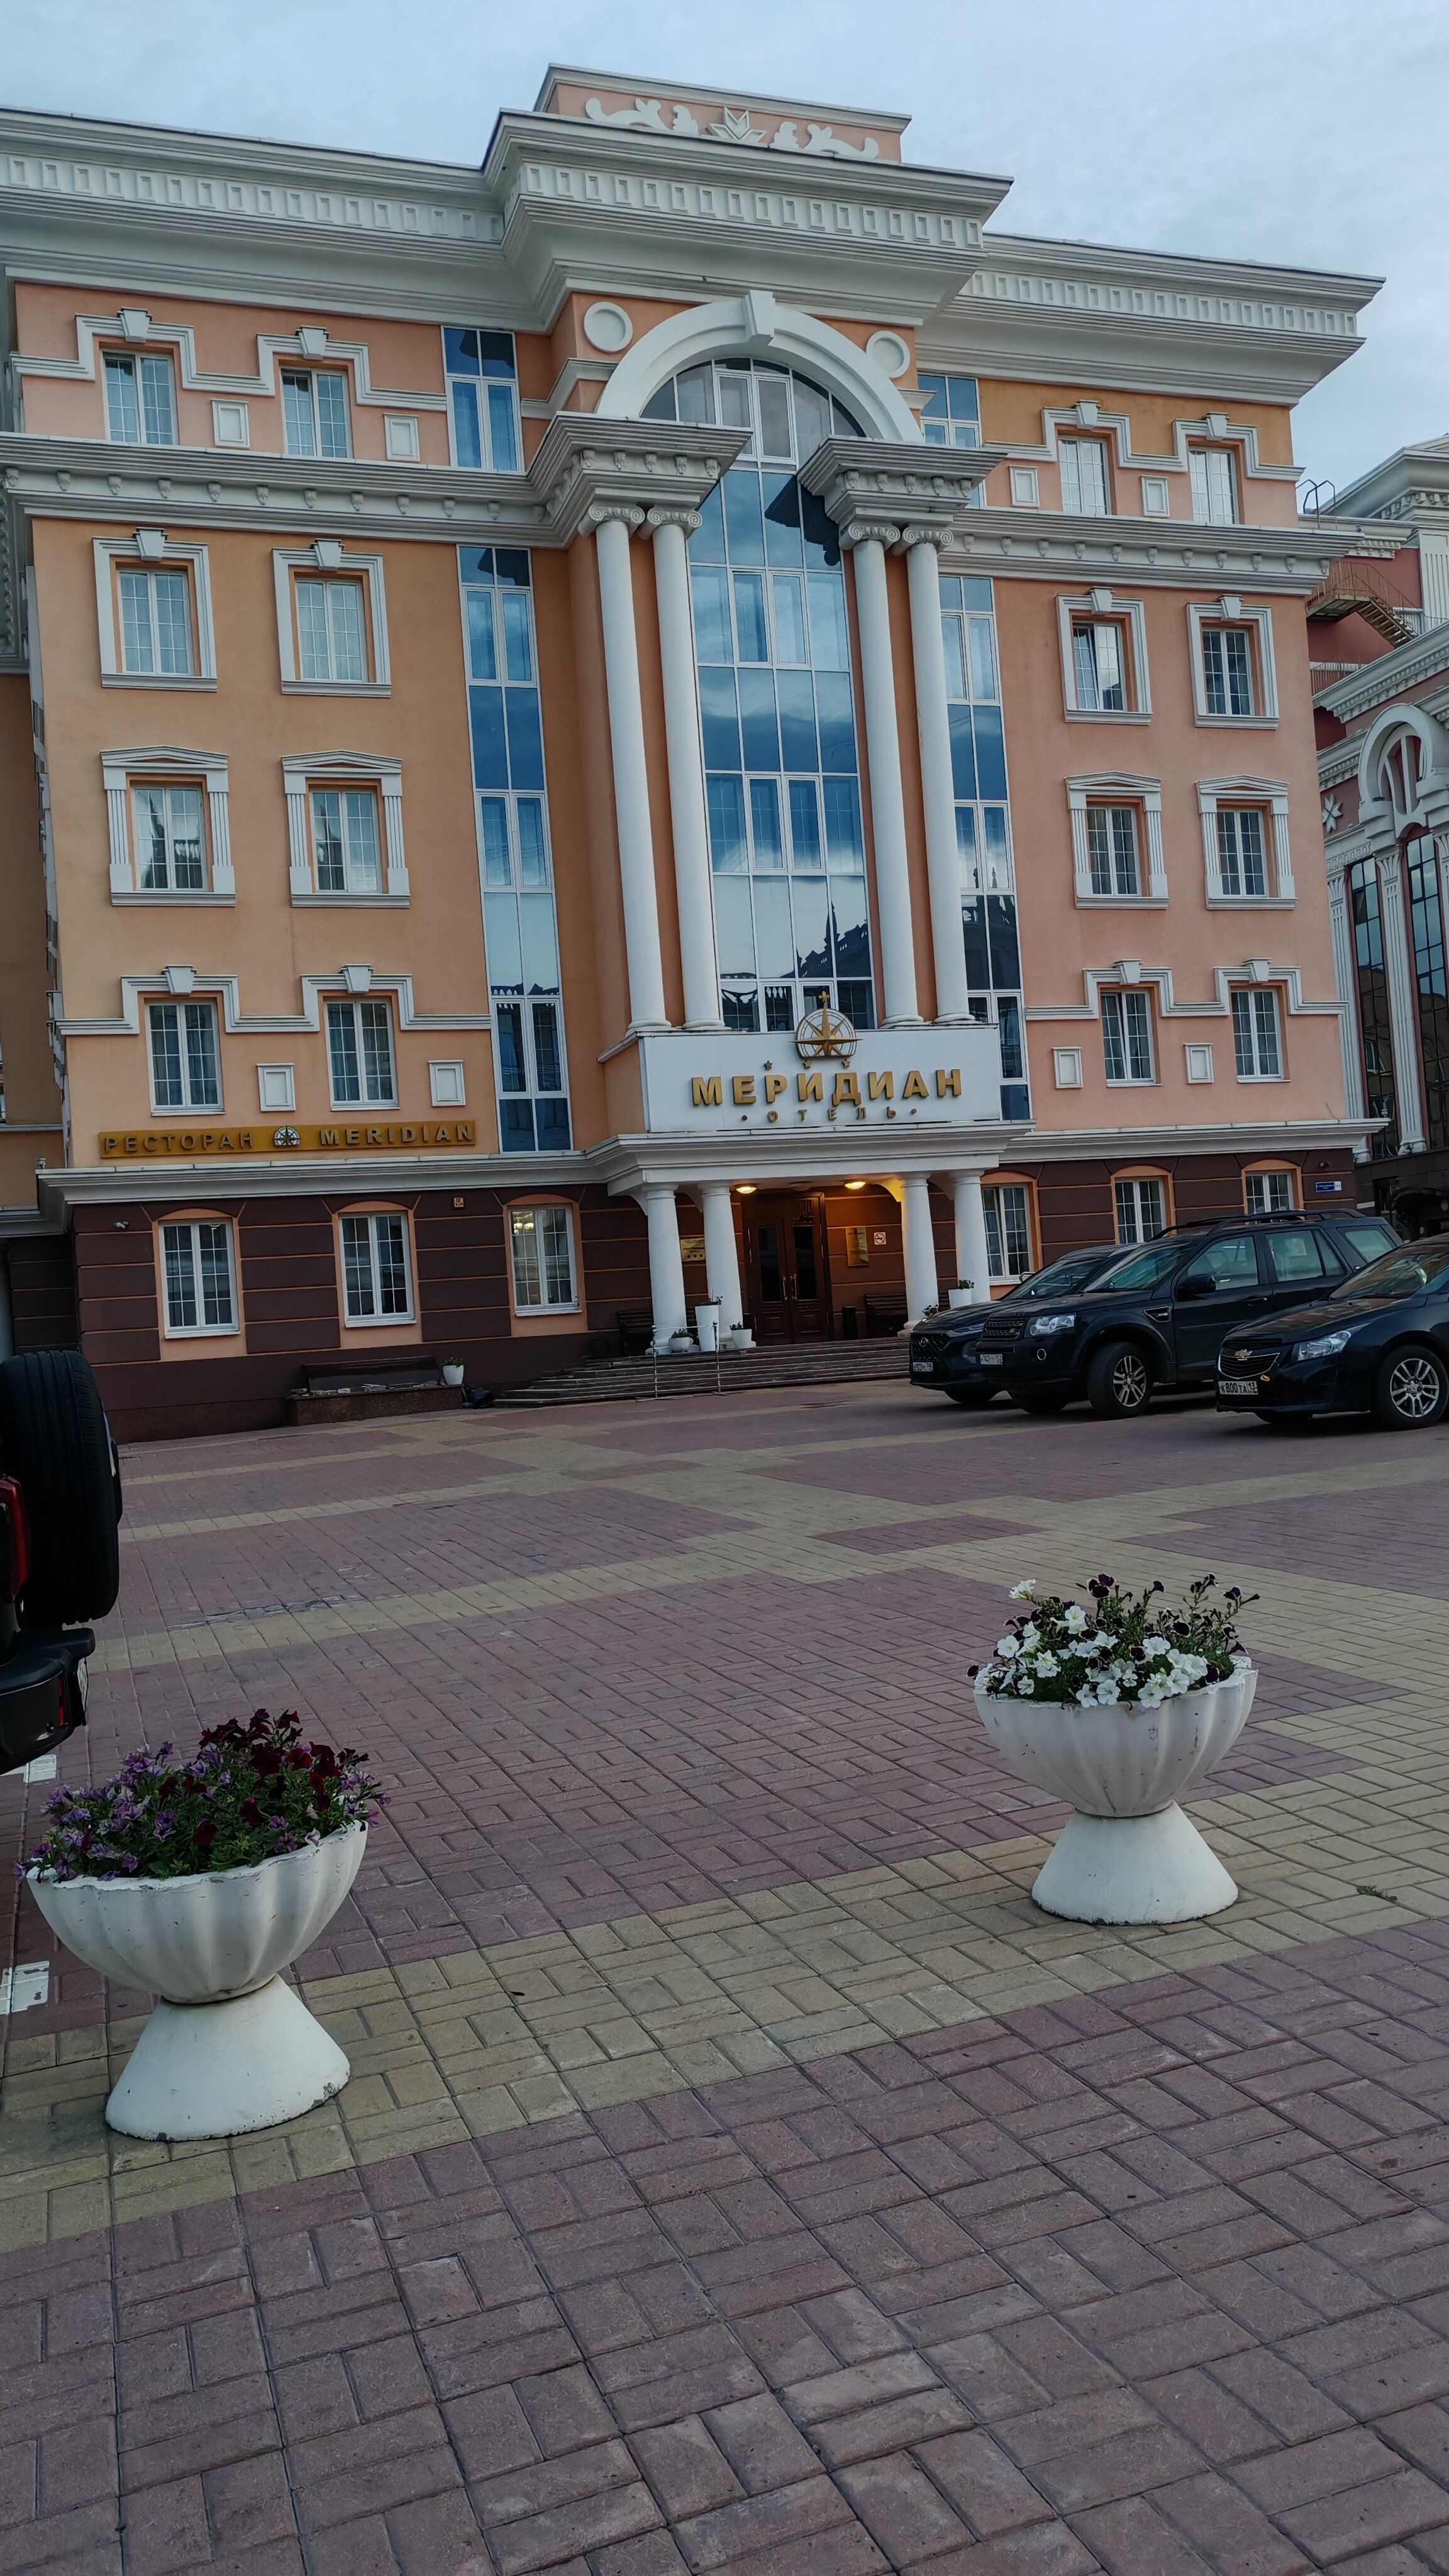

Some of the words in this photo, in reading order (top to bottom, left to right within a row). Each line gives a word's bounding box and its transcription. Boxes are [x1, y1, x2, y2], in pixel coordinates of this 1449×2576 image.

[691, 1069, 962, 1106] МЕРИДИАН
[767, 1106, 897, 1123] ОТЕЛЬ
[105, 1132, 253, 1152] РЕСТОРАН
[320, 1124, 472, 1145] MERIDIAN
